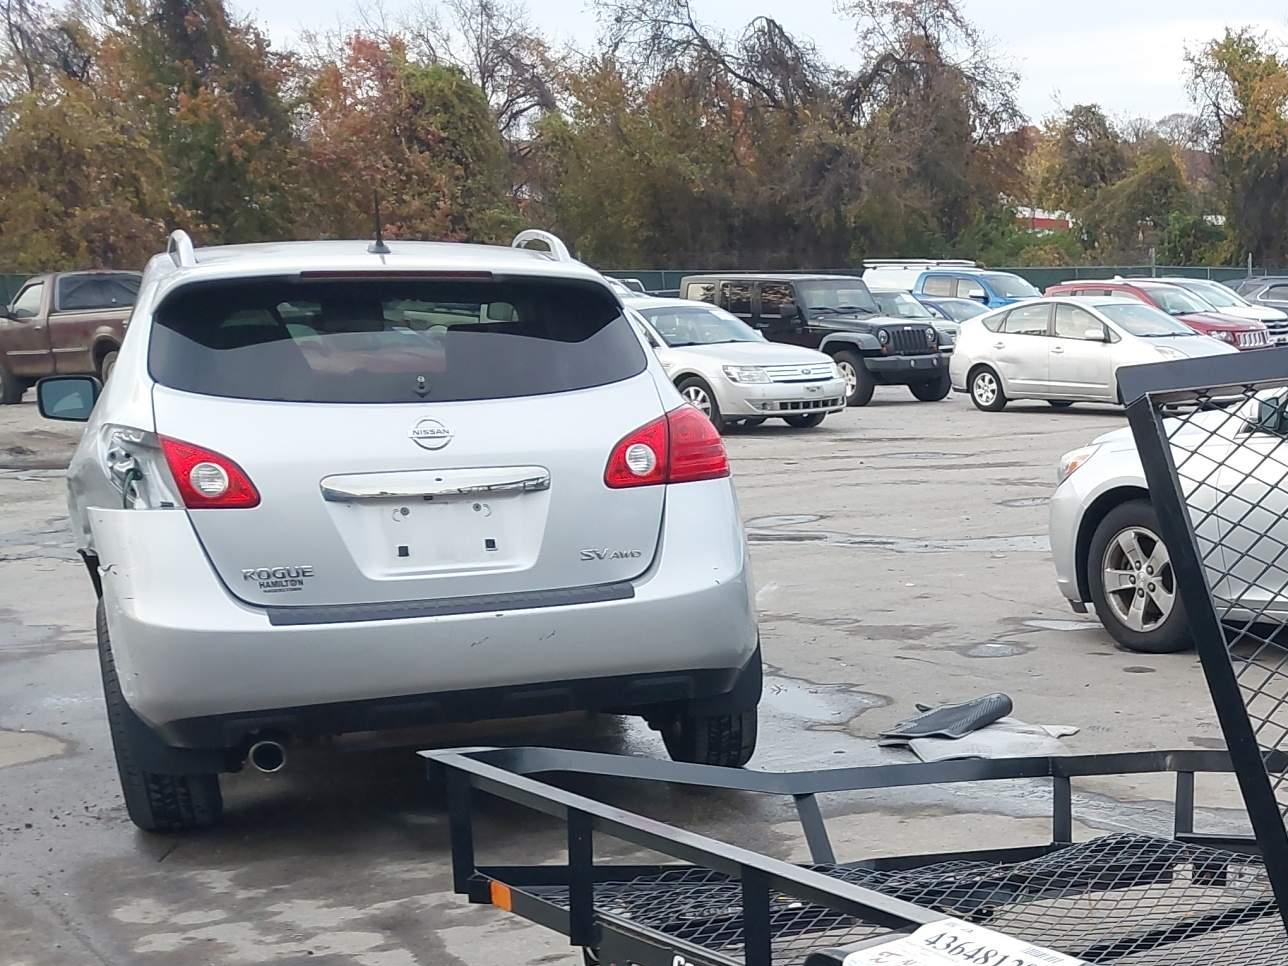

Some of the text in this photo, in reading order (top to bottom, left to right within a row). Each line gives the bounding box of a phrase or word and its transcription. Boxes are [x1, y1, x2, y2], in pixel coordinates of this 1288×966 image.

[580, 548, 642, 561] SV AWD
[241, 566, 315, 581] ROGUE
[258, 579, 304, 589] HAMILTON
